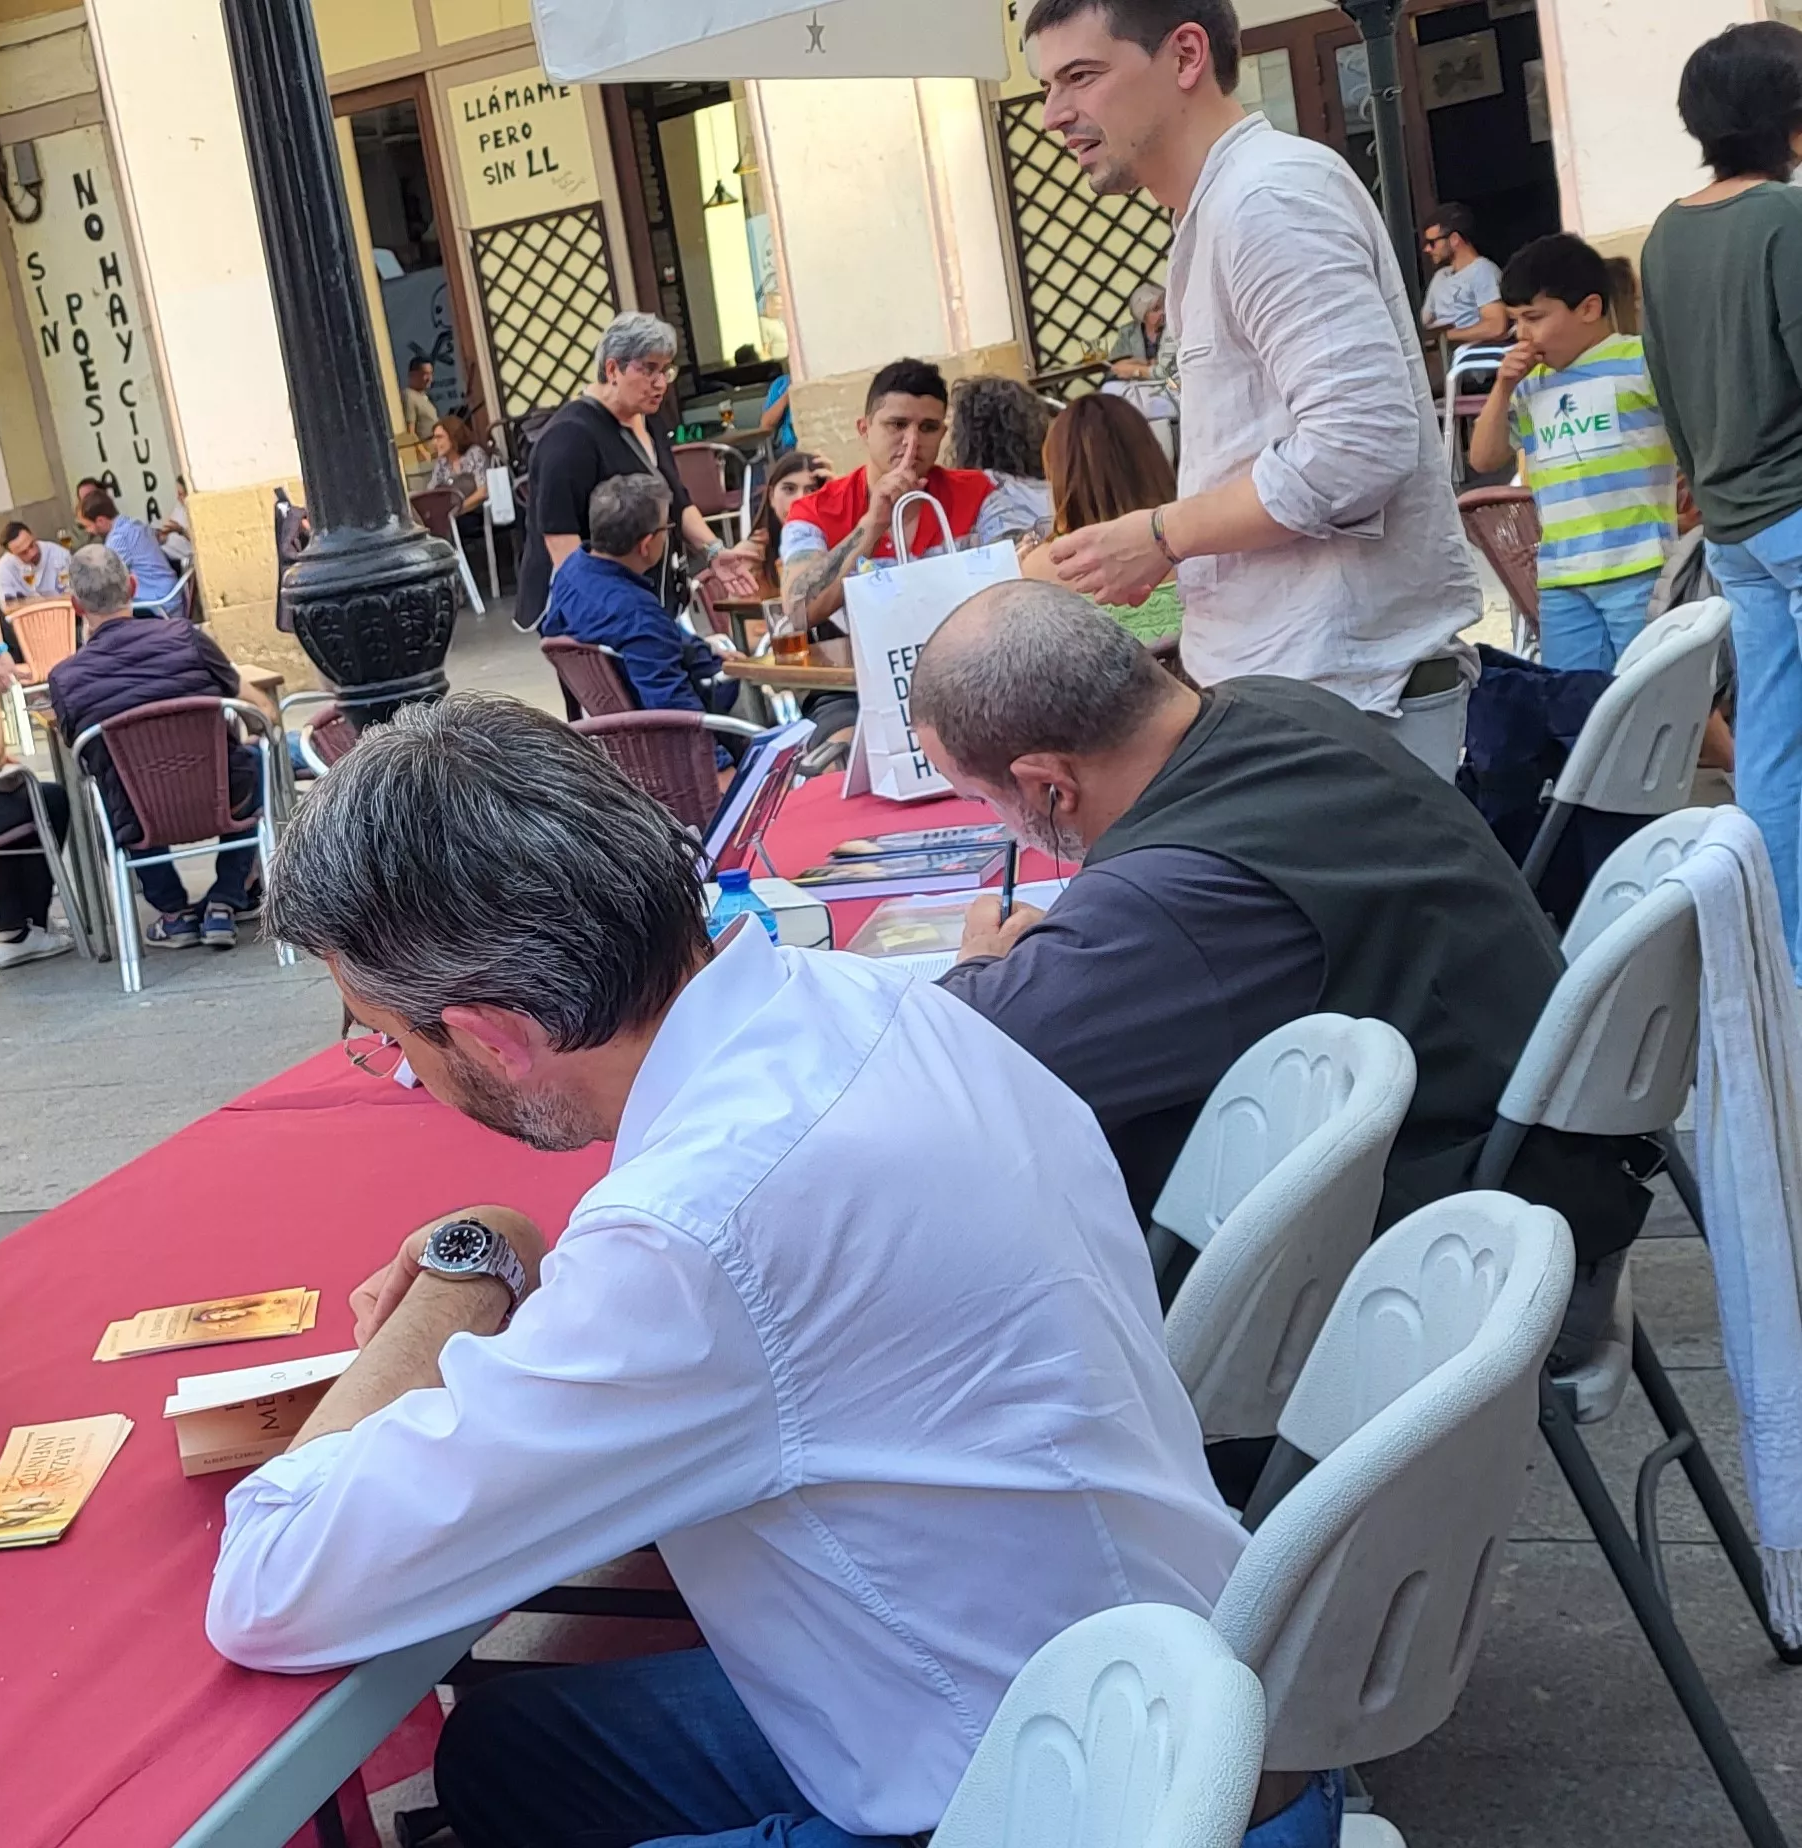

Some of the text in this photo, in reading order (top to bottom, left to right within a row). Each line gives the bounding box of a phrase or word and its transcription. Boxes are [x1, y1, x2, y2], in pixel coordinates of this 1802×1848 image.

[464, 83, 571, 122] LLÁMAME
[479, 122, 532, 153] PERO
[483, 160, 516, 186] SIN
[526, 146, 559, 179] LL
[72, 169, 104, 242] NO
[100, 252, 133, 364] HAY
[27, 251, 61, 357] SIN
[66, 293, 121, 498] POESIA
[1539, 413, 1612, 446] WAVE
